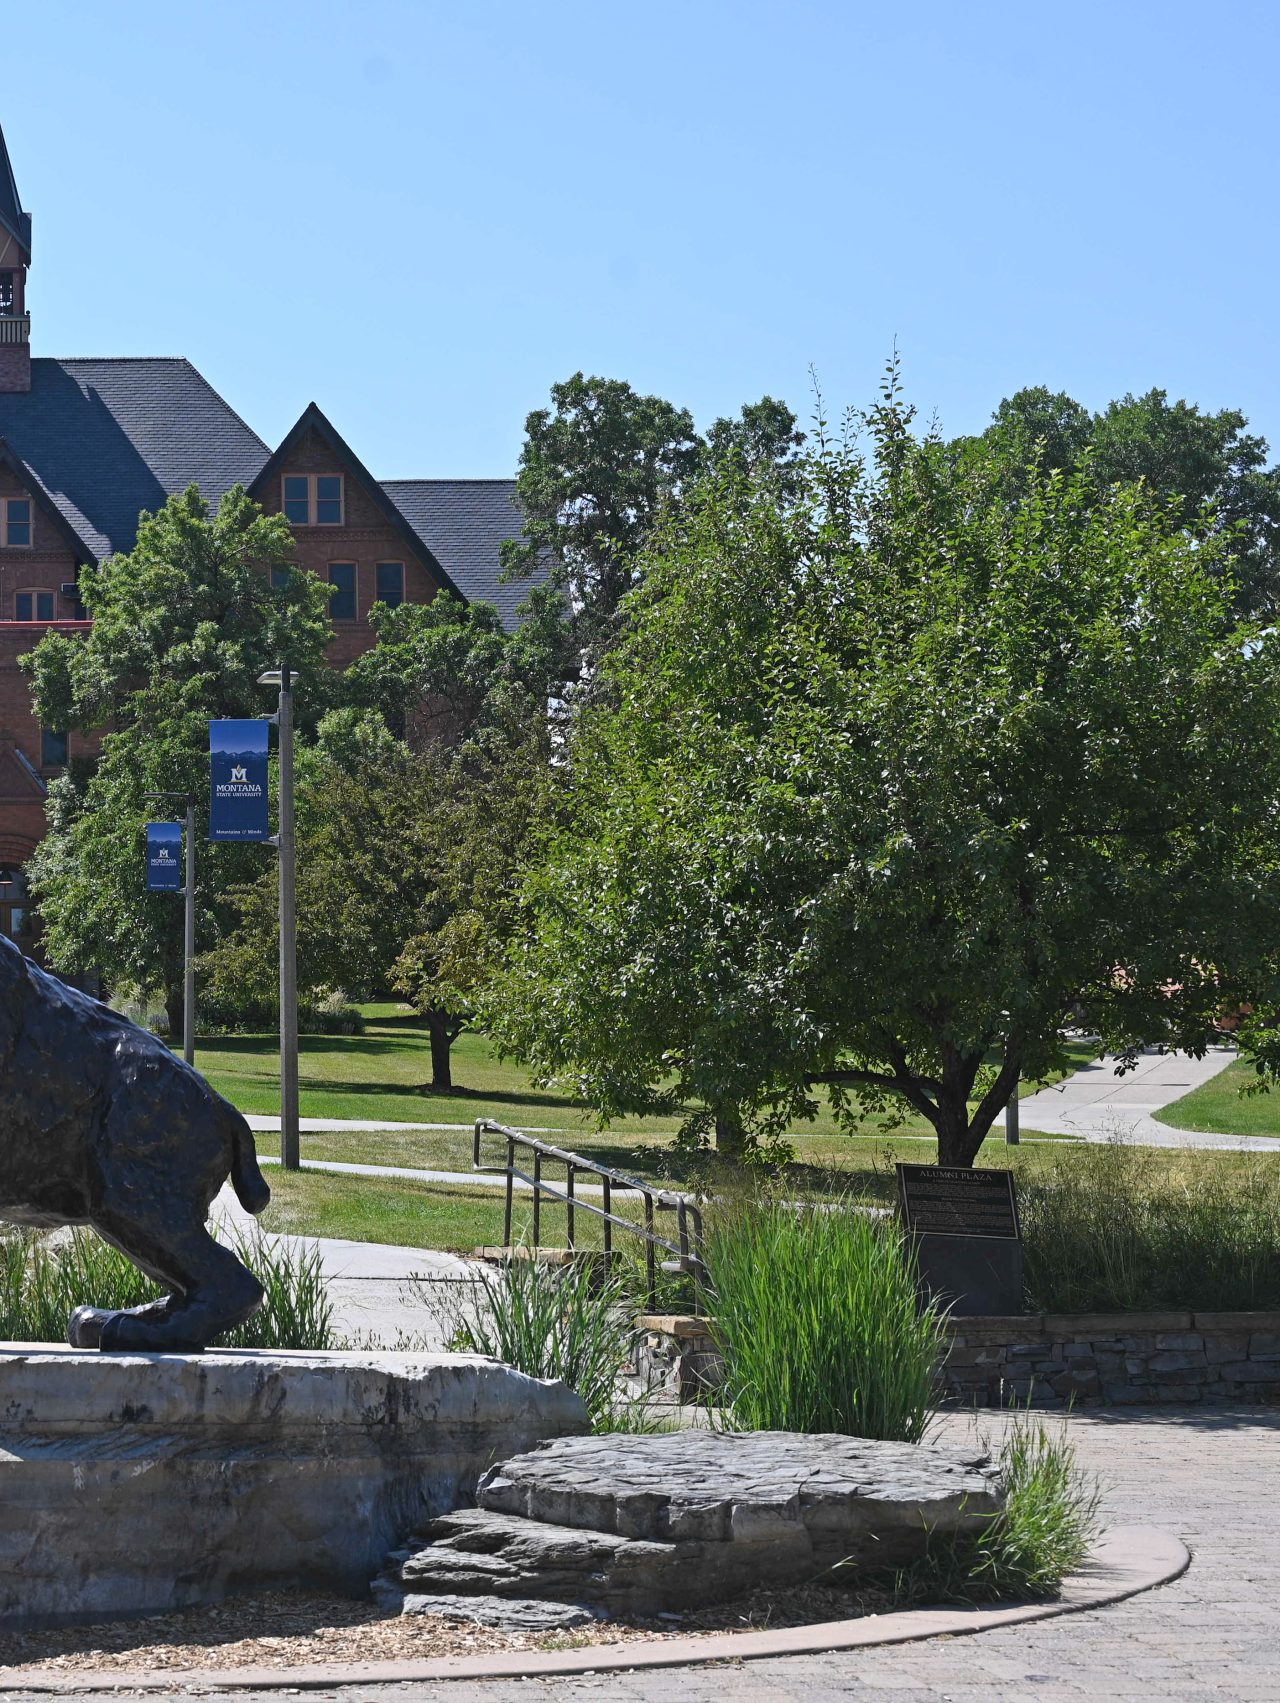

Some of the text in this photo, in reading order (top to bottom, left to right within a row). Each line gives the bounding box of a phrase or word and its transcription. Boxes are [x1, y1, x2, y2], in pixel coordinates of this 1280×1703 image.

[231, 768, 247, 781] M
[216, 784, 262, 792] MONTANA
[919, 1170, 993, 1181] ALUMNI PLAZA
